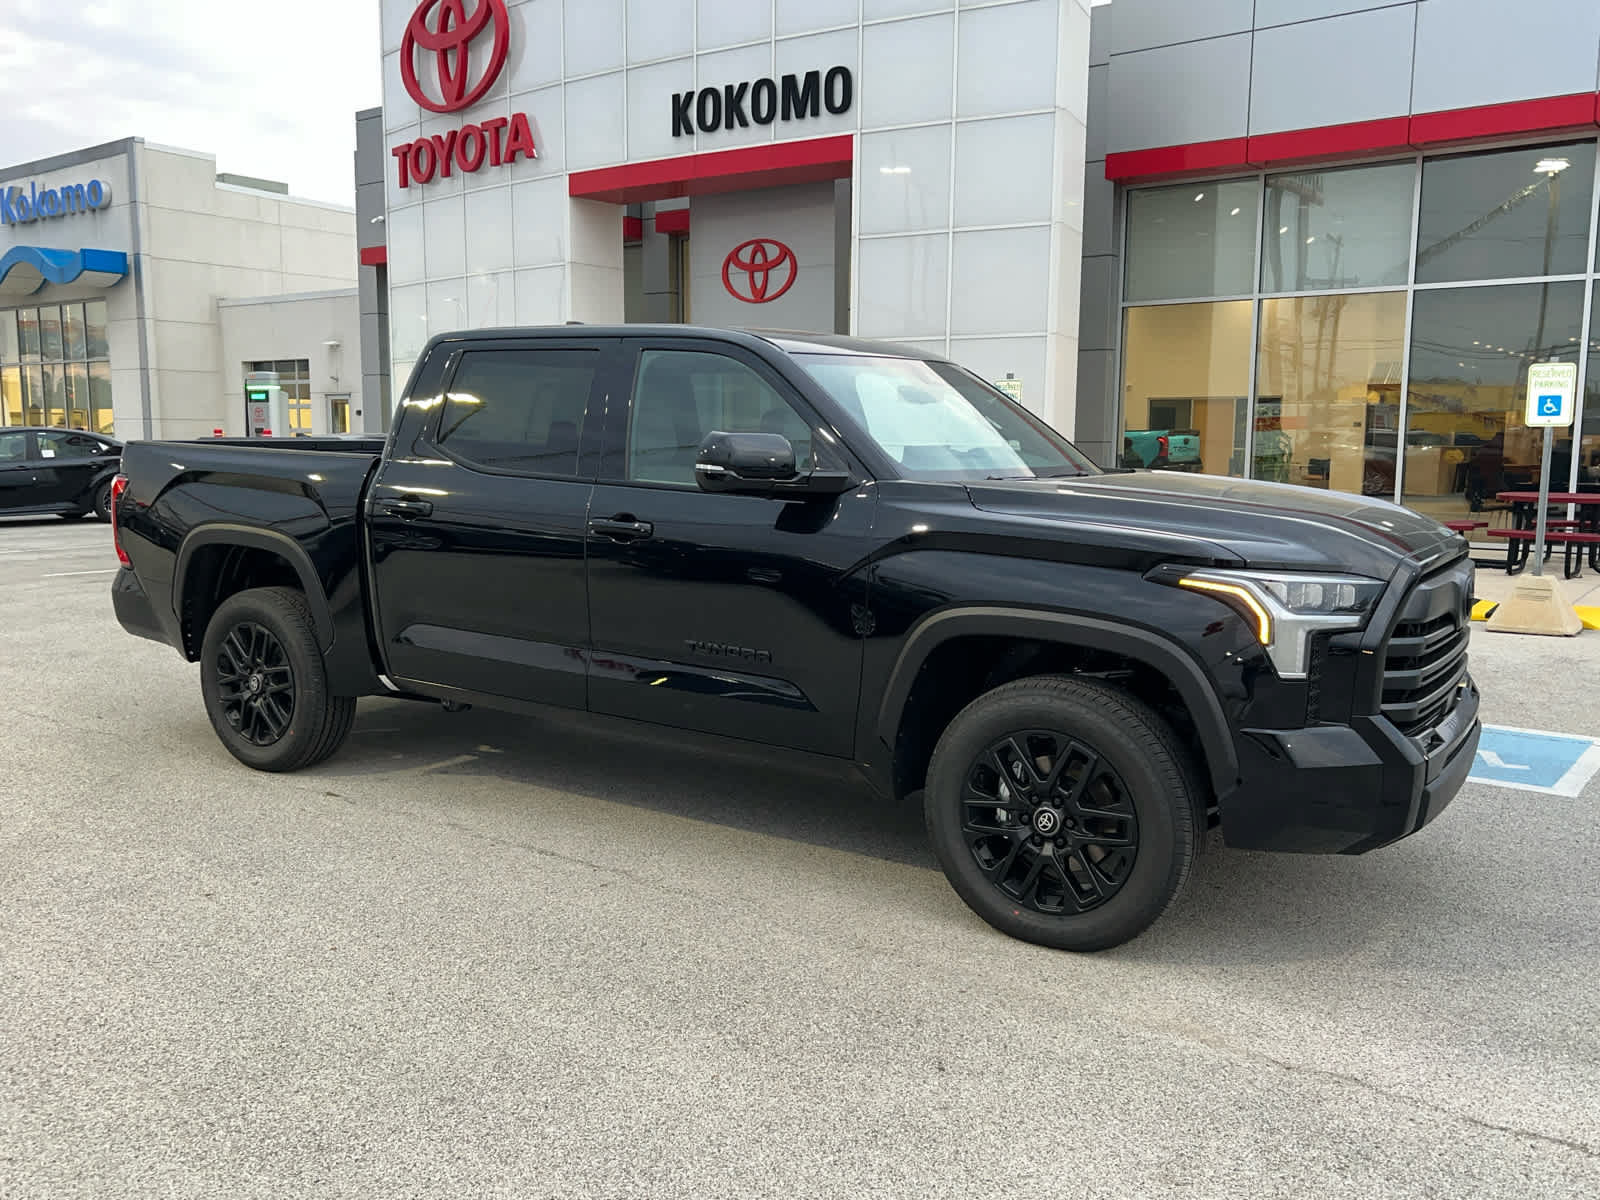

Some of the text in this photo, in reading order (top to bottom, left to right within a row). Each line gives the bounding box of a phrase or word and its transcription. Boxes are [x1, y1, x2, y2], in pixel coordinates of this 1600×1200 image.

[672, 66, 853, 137] KOKOMO
[392, 112, 537, 188] TOYOTA
[0, 179, 111, 225] Kokomo
[685, 639, 773, 664] TUNDRA
